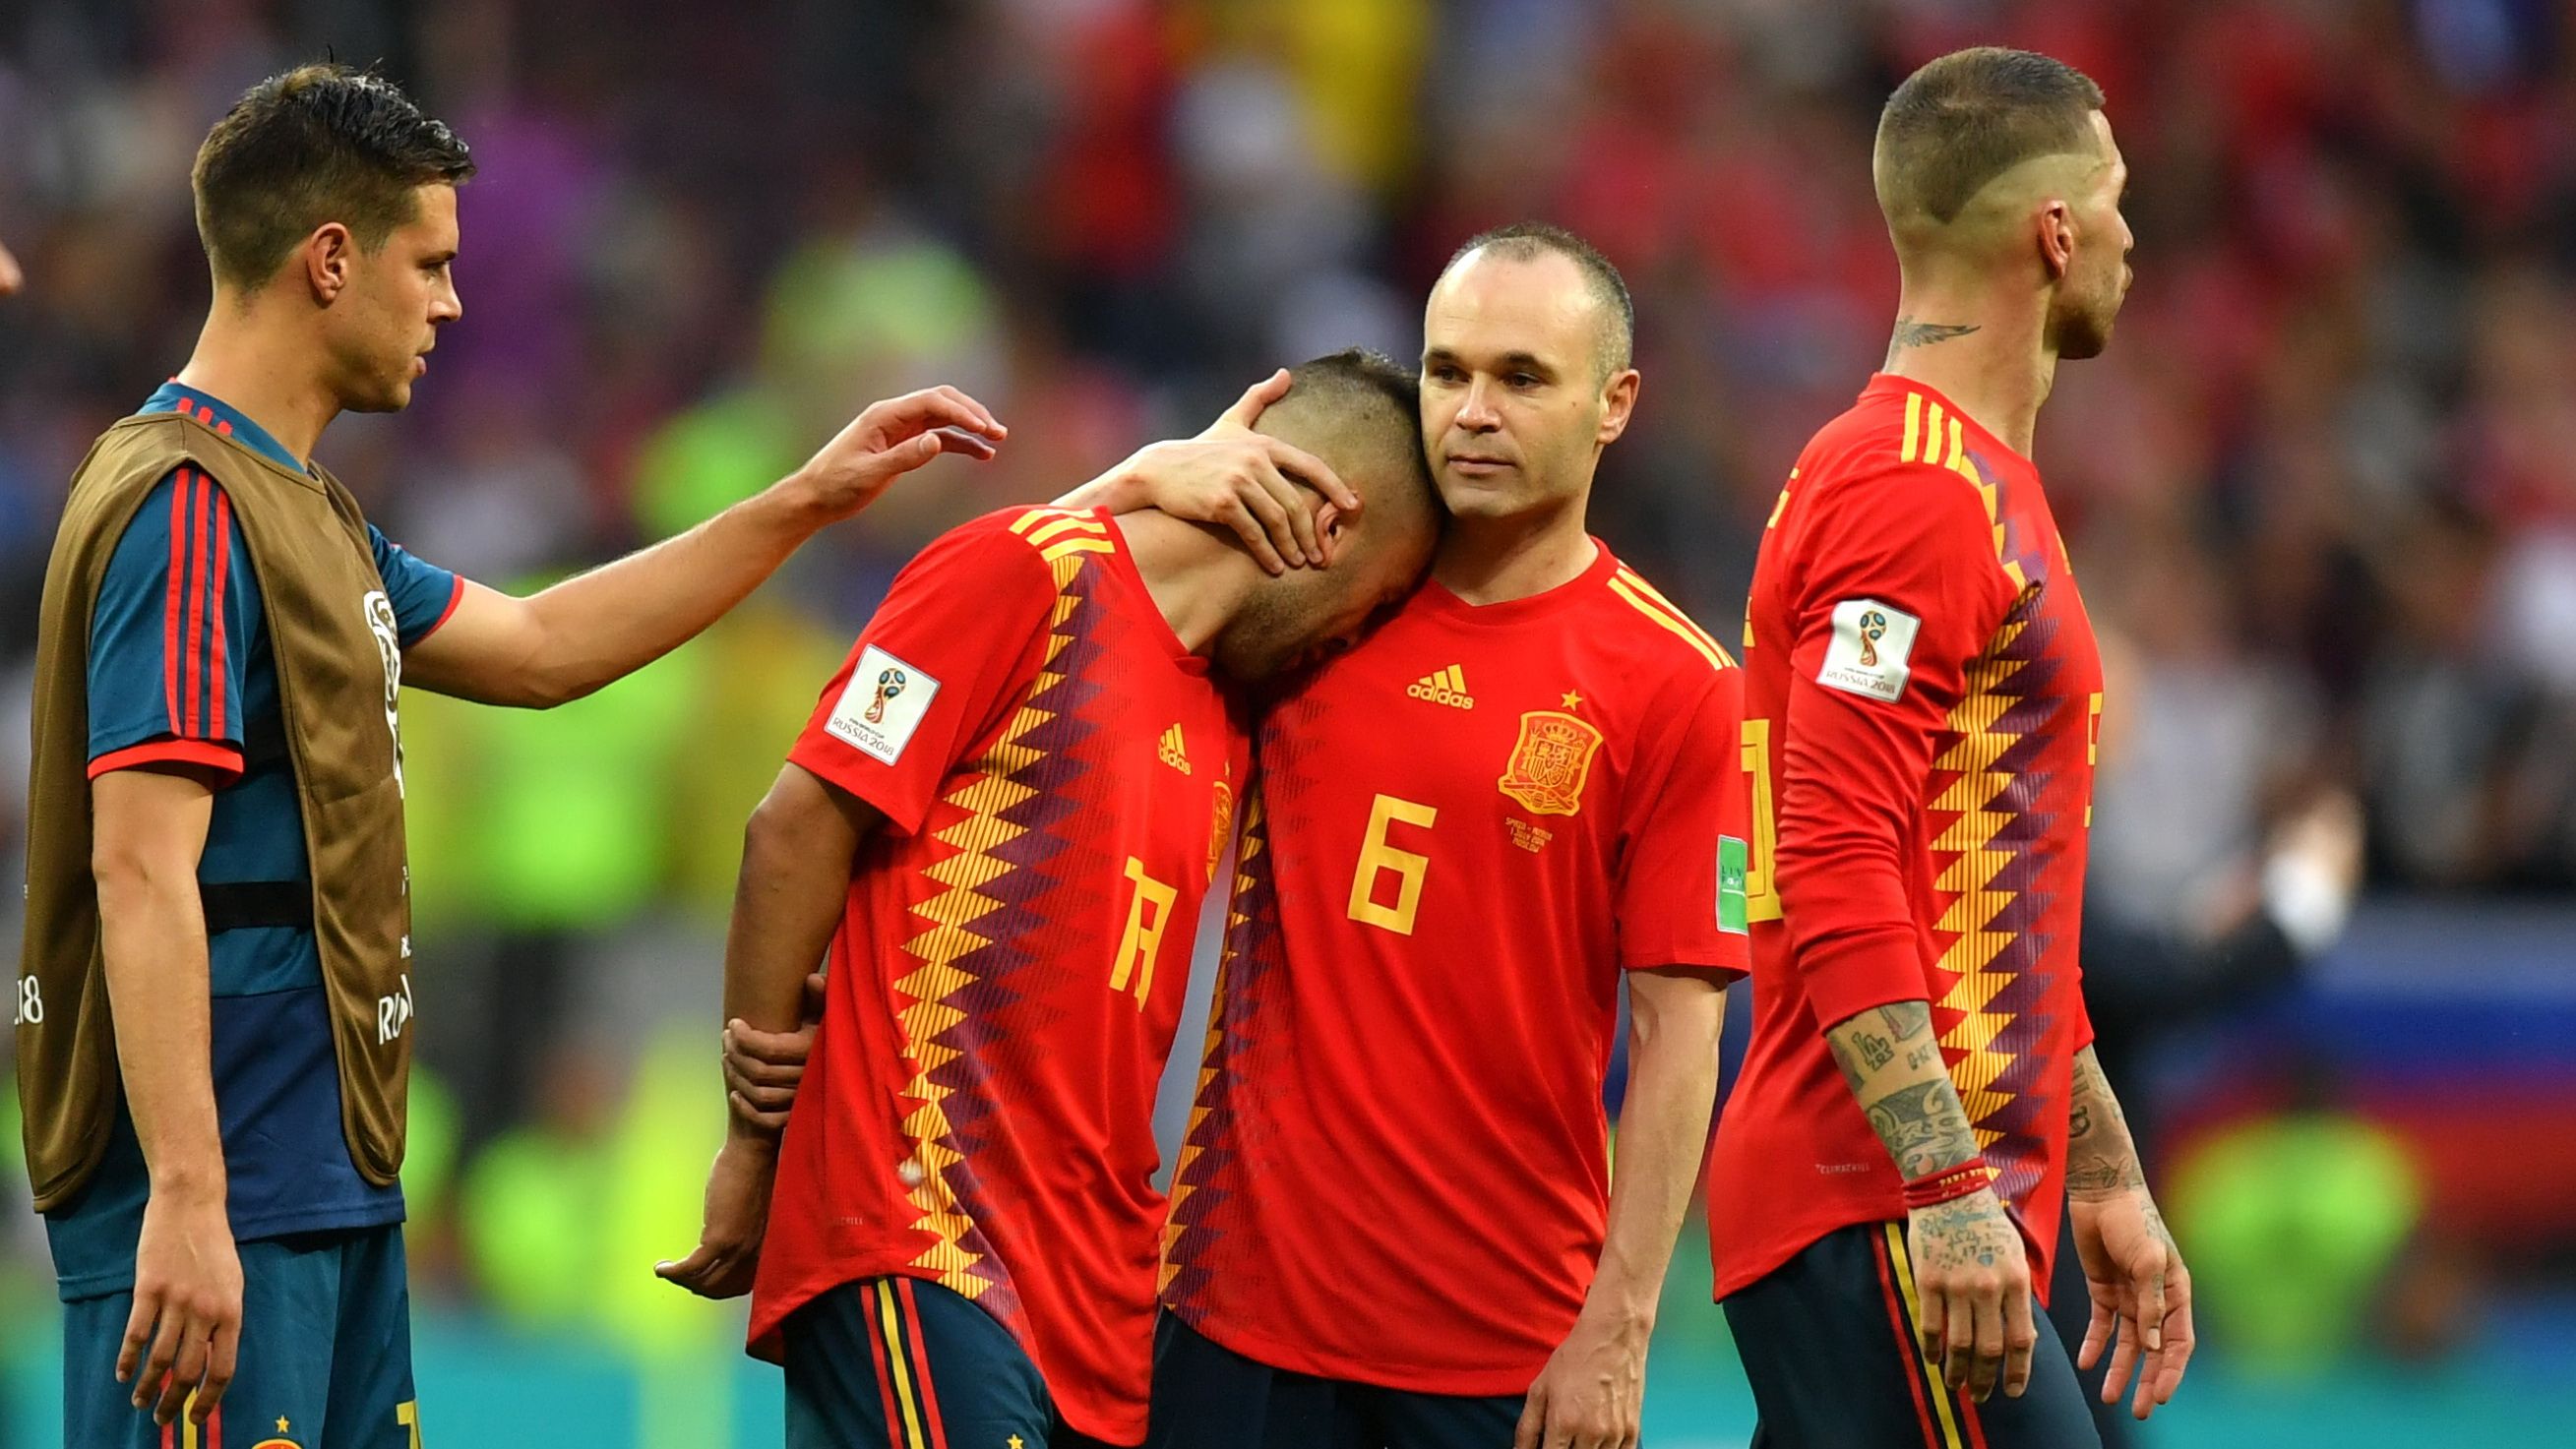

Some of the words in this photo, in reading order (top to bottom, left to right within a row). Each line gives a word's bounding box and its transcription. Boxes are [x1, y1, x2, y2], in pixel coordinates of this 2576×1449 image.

[1407, 684, 1474, 710] adidas
[1826, 670, 1869, 688] RUSSIA
[1870, 680, 1896, 694] 2018
[831, 716, 870, 743] RUSSIA
[869, 737, 895, 755] 2018
[1347, 793, 1438, 936] 6
